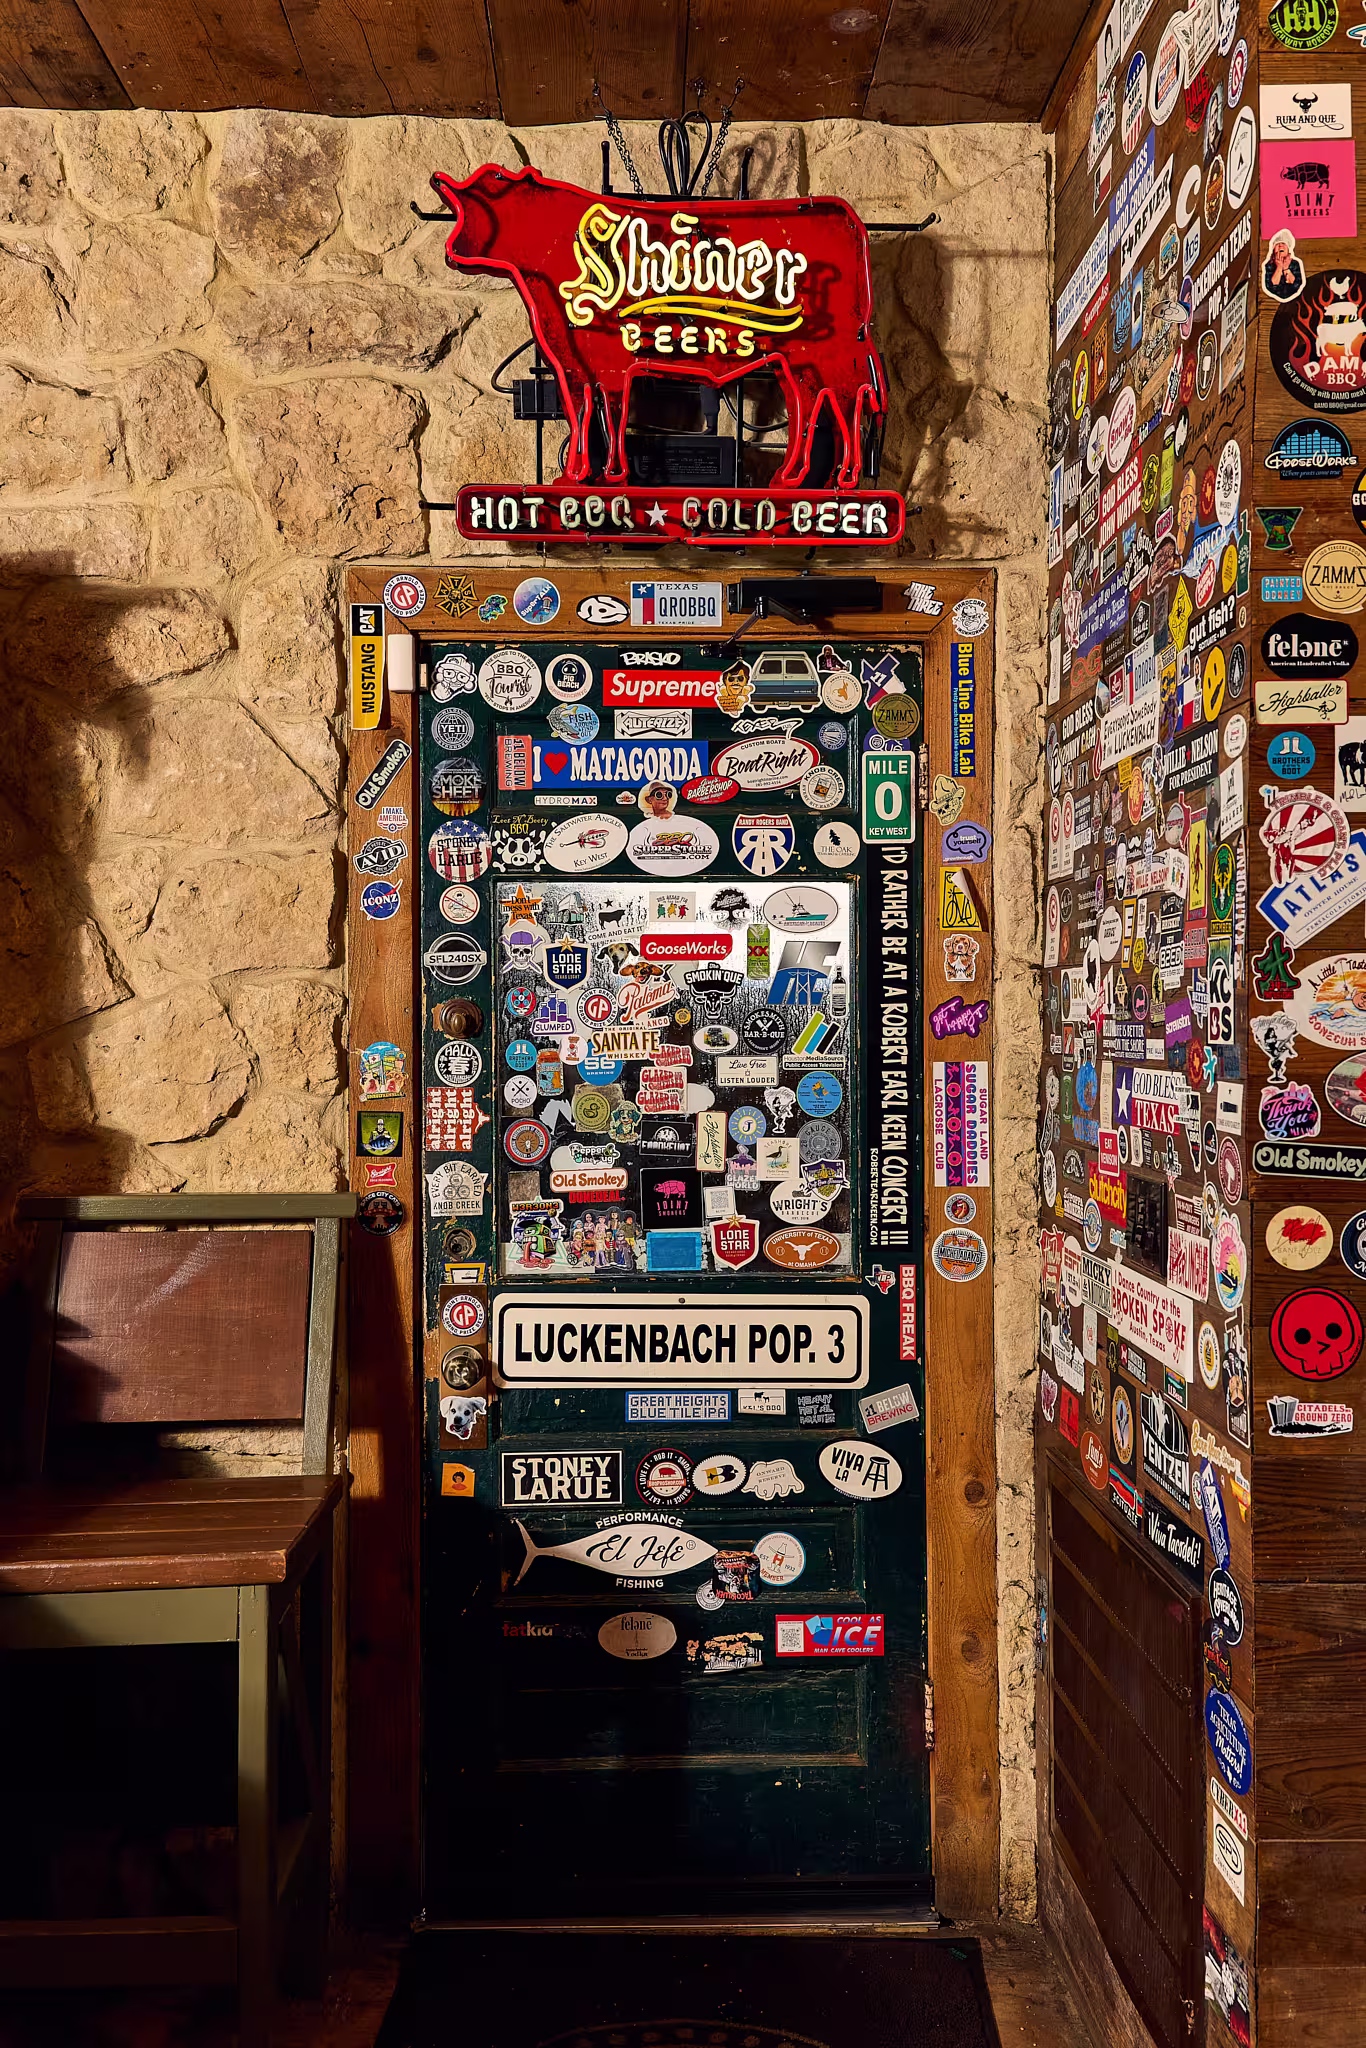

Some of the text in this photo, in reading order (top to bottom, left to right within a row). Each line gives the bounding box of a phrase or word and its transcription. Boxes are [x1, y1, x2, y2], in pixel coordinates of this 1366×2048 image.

[1276, 115, 1336, 124] RUM AND QUE
[1285, 193, 1335, 208] JOINT
[1288, 209, 1329, 217] SMOKERS
[1230, 210, 1251, 262] TEXAS
[560, 203, 807, 325] Shiner
[1208, 276, 1229, 325] POP. 3
[621, 325, 755, 355] BEERS
[1327, 373, 1357, 386] BBQ
[1102, 457, 1139, 517] GOD BLESS
[471, 495, 888, 534] HOT BBQ COLD BEER
[1099, 516, 1116, 549] JOHN
[1116, 482, 1142, 531] WAYNE
[1265, 578, 1301, 588] PAINTED
[1265, 590, 1301, 600] DONKEY
[660, 597, 716, 617] QROBBQ
[359, 608, 375, 634] CAT
[1189, 595, 1235, 650] gut fish?
[362, 643, 375, 714] MUSTANG
[497, 664, 524, 674] BBQ
[557, 680, 580, 688] BEACH
[610, 673, 718, 703] Supreme
[569, 713, 592, 723] FISH
[958, 643, 974, 775] Blue Line Bike Lab
[441, 724, 467, 733] YETI
[1114, 718, 1156, 754] LUCKENBACH
[741, 740, 764, 749] CUSTOM
[1191, 729, 1218, 763] NELSON
[504, 738, 513, 787] BREWING
[533, 746, 702, 782] I MATAGORDA
[869, 760, 908, 774] MILE
[1169, 760, 1212, 791] FOR PRESIDENT
[432, 786, 482, 799] SHEET
[536, 796, 597, 805] HYDROMAX
[875, 781, 902, 820] 0
[379, 814, 406, 822] AMERICA
[652, 832, 693, 846] BBQ
[869, 827, 908, 836] KEY WEST
[437, 837, 482, 849] STONEY
[953, 838, 981, 846] yourself
[438, 851, 482, 866] LARUE
[362, 894, 398, 907] ICONZ
[503, 903, 540, 912] mess with
[511, 896, 531, 904] Don't
[880, 869, 909, 930] RATHER
[1212, 923, 1232, 934] MEMBER
[882, 937, 907, 955] BE
[552, 954, 581, 963] LONE
[552, 964, 582, 974] STAR
[882, 961, 907, 980] AT
[883, 986, 907, 998] A
[535, 1022, 570, 1032] SLUMPED
[880, 1003, 908, 1064] ROBERT
[1309, 1015, 1357, 1046] CONECUH
[585, 1057, 616, 1070] 56
[881, 1070, 908, 1107] EARL
[427, 1088, 442, 1150] alright
[444, 1088, 457, 1150] alright
[461, 1088, 474, 1150] alright
[934, 1078, 944, 1170] LACROSSE CLUB
[965, 1064, 979, 1184] SUGAR DADDIES
[979, 1088, 988, 1161] SUGAR LAND
[1135, 1100, 1175, 1133] TEXAS
[882, 1114, 907, 1149] KEEN
[1104, 1138, 1112, 1149] EAT
[1256, 1147, 1366, 1177] Old Smokey
[553, 1173, 625, 1187] Old Smokey
[881, 1155, 908, 1224] CONCERT
[433, 1200, 481, 1210] KNOB CREEK
[870, 1148, 878, 1246] ROBERTEARLKEEN.COM
[1089, 1174, 1127, 1218] clutchcity
[772, 1201, 828, 1212] WRIGHT'S
[720, 1230, 749, 1240] LONE
[721, 1241, 750, 1250] STAR
[1082, 1256, 1111, 1286] MICKY
[902, 1266, 914, 1358] BBQ FREAK
[514, 1323, 844, 1364] LUCKENBACH POP. 3
[630, 1396, 727, 1407] GREAT HEIGHTS
[630, 1408, 727, 1418] BLUE TILE IPA
[867, 1404, 914, 1426] BREWING
[1295, 1413, 1352, 1422] GROUND ZERO
[512, 1457, 611, 1477] STONEY
[1142, 1423, 1190, 1496] YENTZEN
[835, 1469, 850, 1482] LA
[513, 1477, 611, 1500] LARUE
[1113, 1492, 1138, 1524] SCITUATE
[596, 1512, 684, 1530] PERFORMANCE
[615, 1577, 664, 1589] FISHING
[833, 1625, 878, 1646] ICE
[1219, 1704, 1237, 1733] TEXAS
[1210, 1710, 1247, 1764] AGRICULTURE
